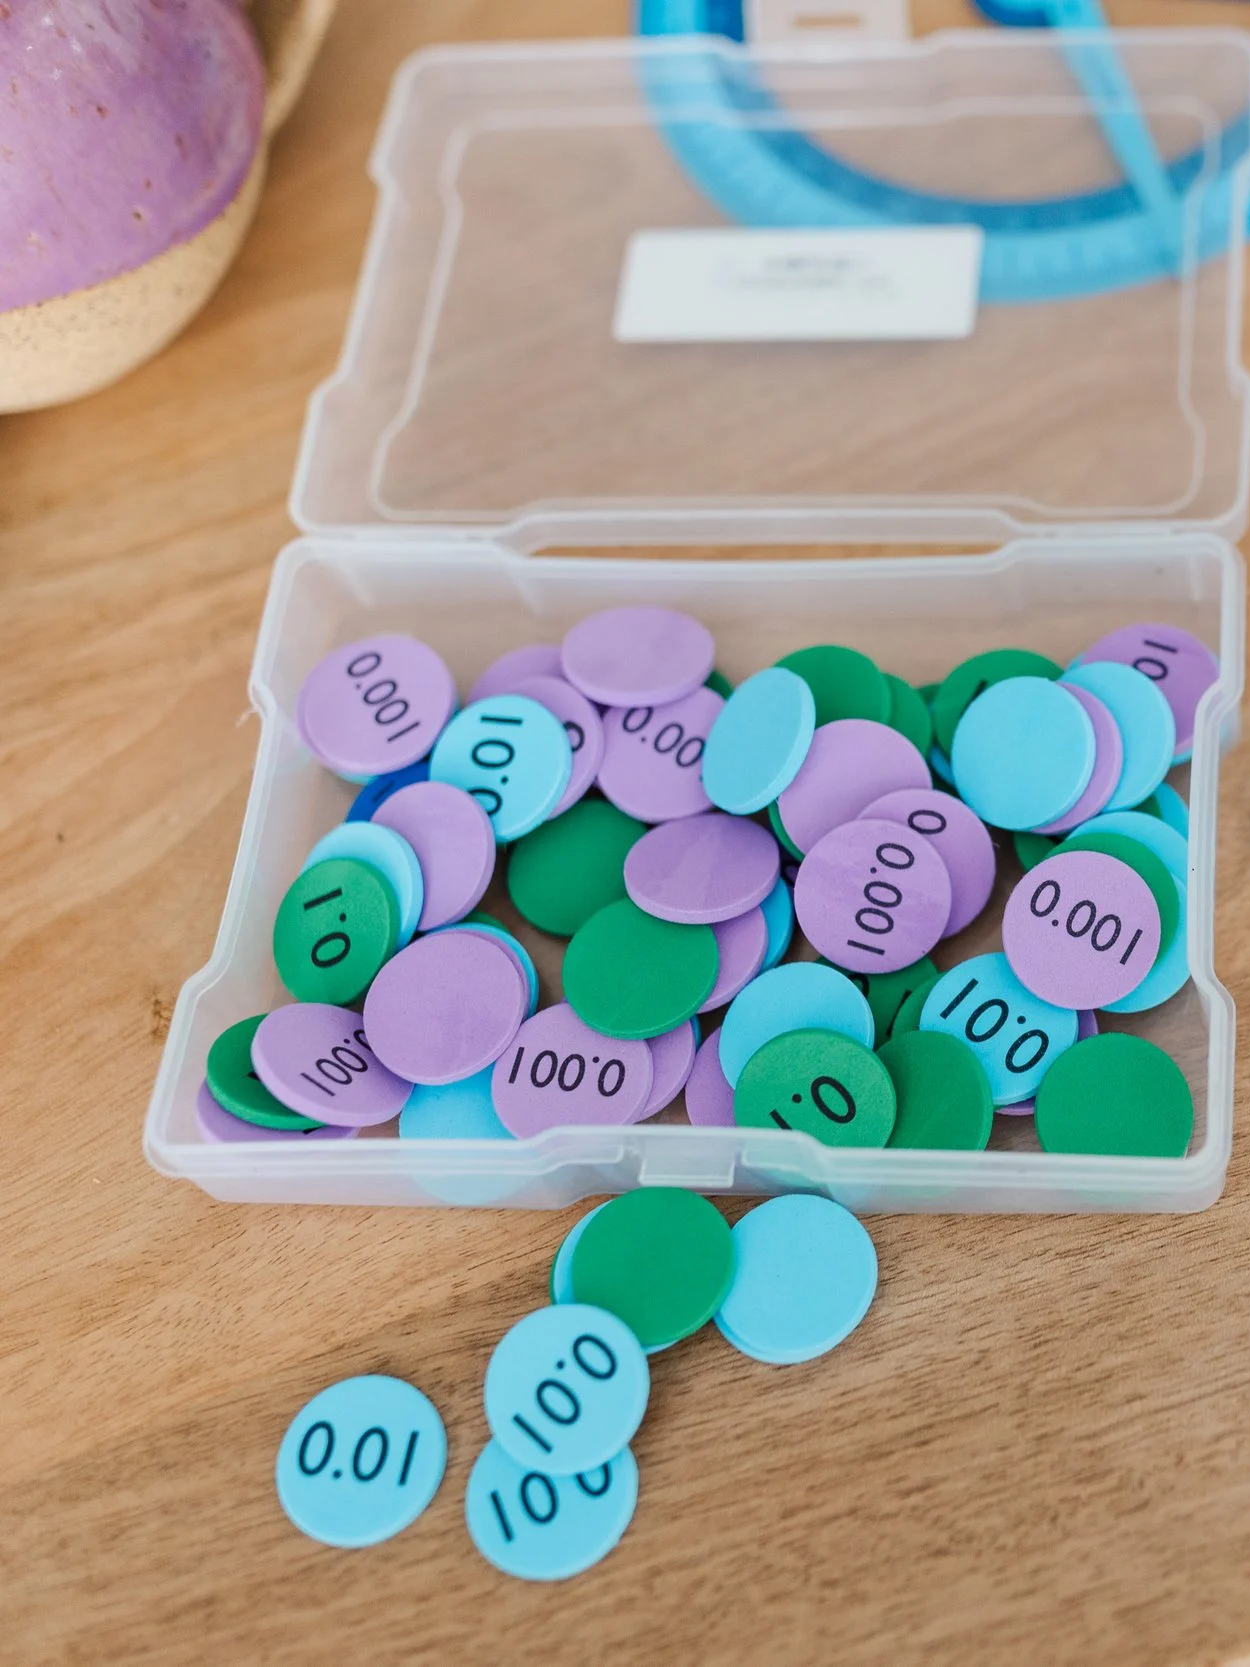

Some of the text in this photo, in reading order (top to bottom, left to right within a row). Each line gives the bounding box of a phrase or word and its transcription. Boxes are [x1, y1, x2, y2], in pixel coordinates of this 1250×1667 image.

[346, 652, 421, 743] 0.001
[622, 706, 705, 781] 0.00
[303, 888, 350, 968] 0.1
[847, 843, 914, 955] 0.001
[1030, 879, 1143, 965] 0.001
[940, 978, 1049, 1073] 0.01
[508, 1047, 625, 1097] 0.001
[512, 1334, 617, 1453] 0.01
[299, 1421, 419, 1486] 0.01
